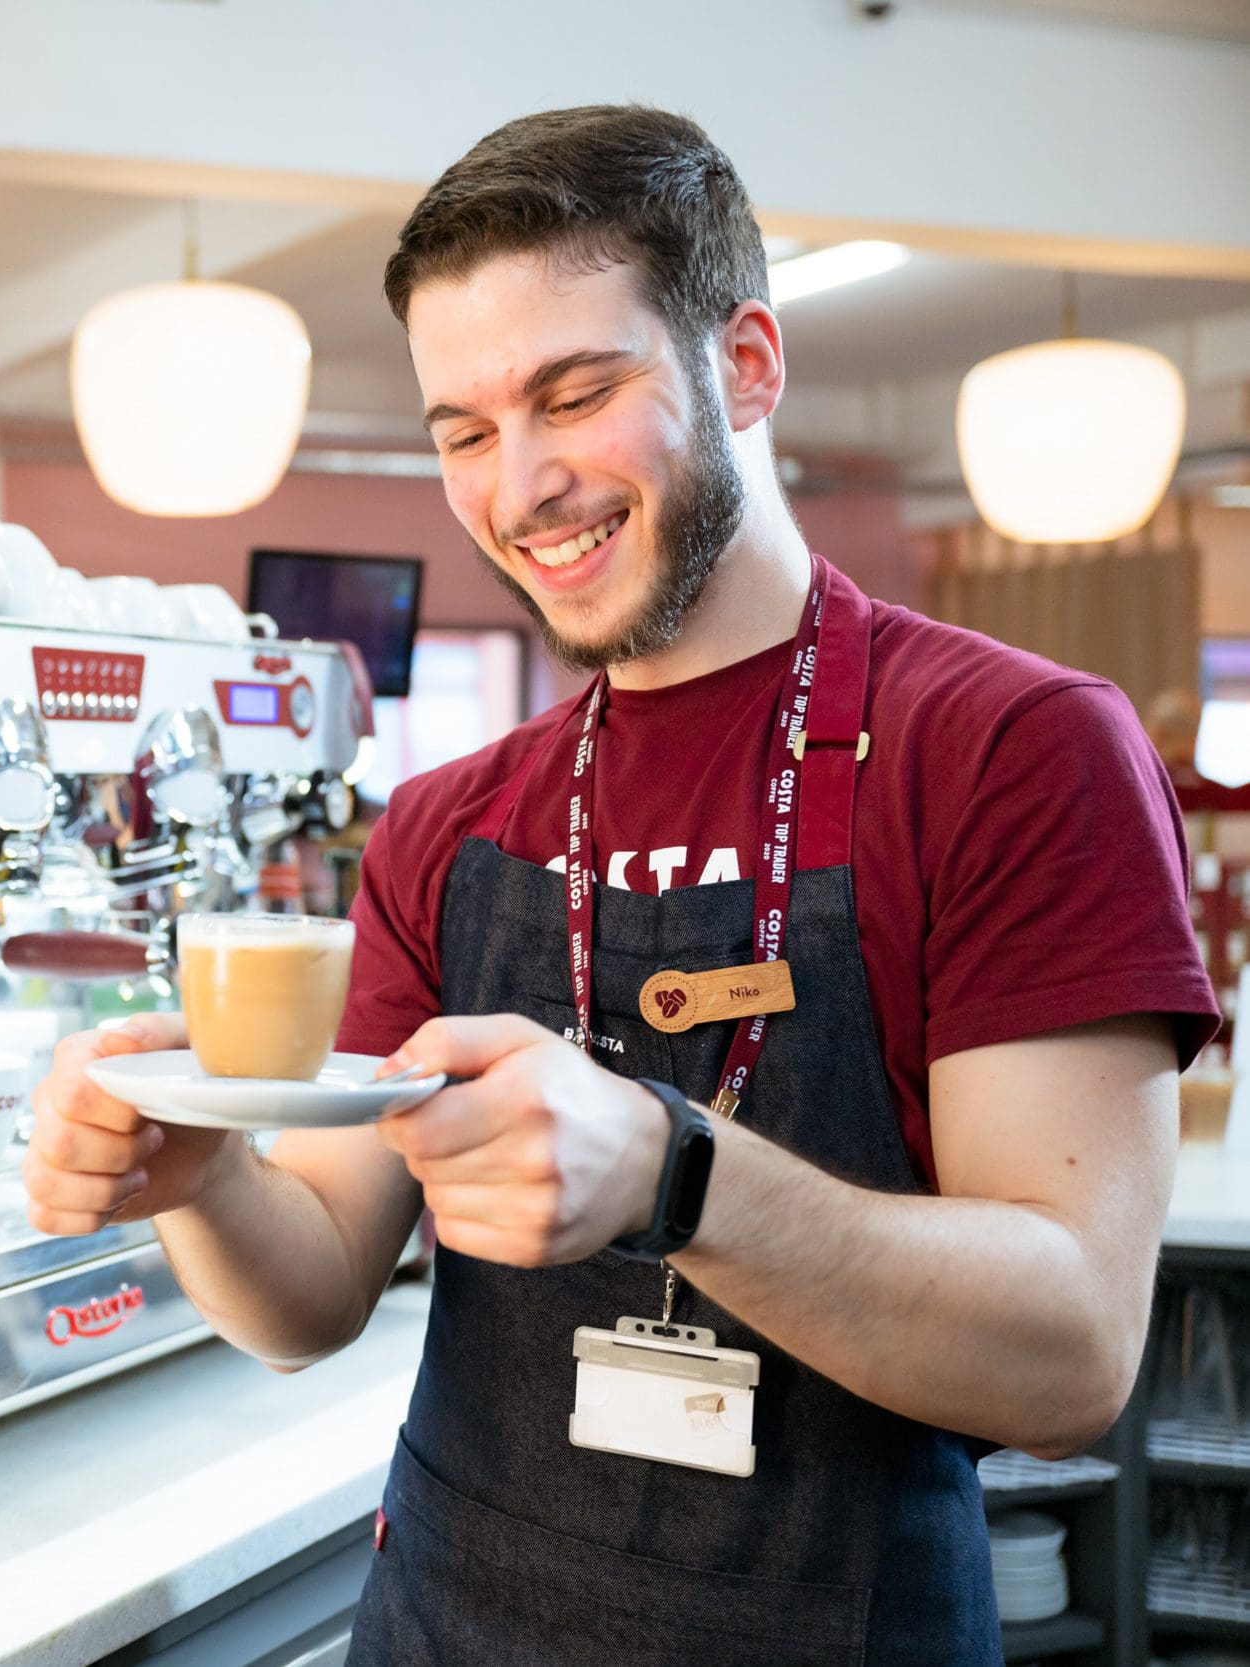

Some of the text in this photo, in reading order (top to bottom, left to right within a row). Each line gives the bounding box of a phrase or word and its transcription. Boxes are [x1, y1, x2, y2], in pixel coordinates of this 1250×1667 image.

[794, 694, 809, 714] TOP
[573, 735, 589, 778] COSTA
[768, 777, 778, 804] COFFEE
[777, 769, 796, 814] COSTA
[570, 794, 581, 855] TOP TRADER
[545, 846, 741, 898] STA
[762, 842, 771, 861] 2020
[770, 822, 790, 884] TOP TRADER
[569, 860, 582, 910] COSTA
[572, 931, 583, 974] TRADER
[758, 918, 766, 949] COFFEE
[765, 908, 782, 962] COSTA
[575, 975, 584, 996] TOP
[729, 986, 760, 1000] Niko
[731, 1065, 748, 1097] CO
